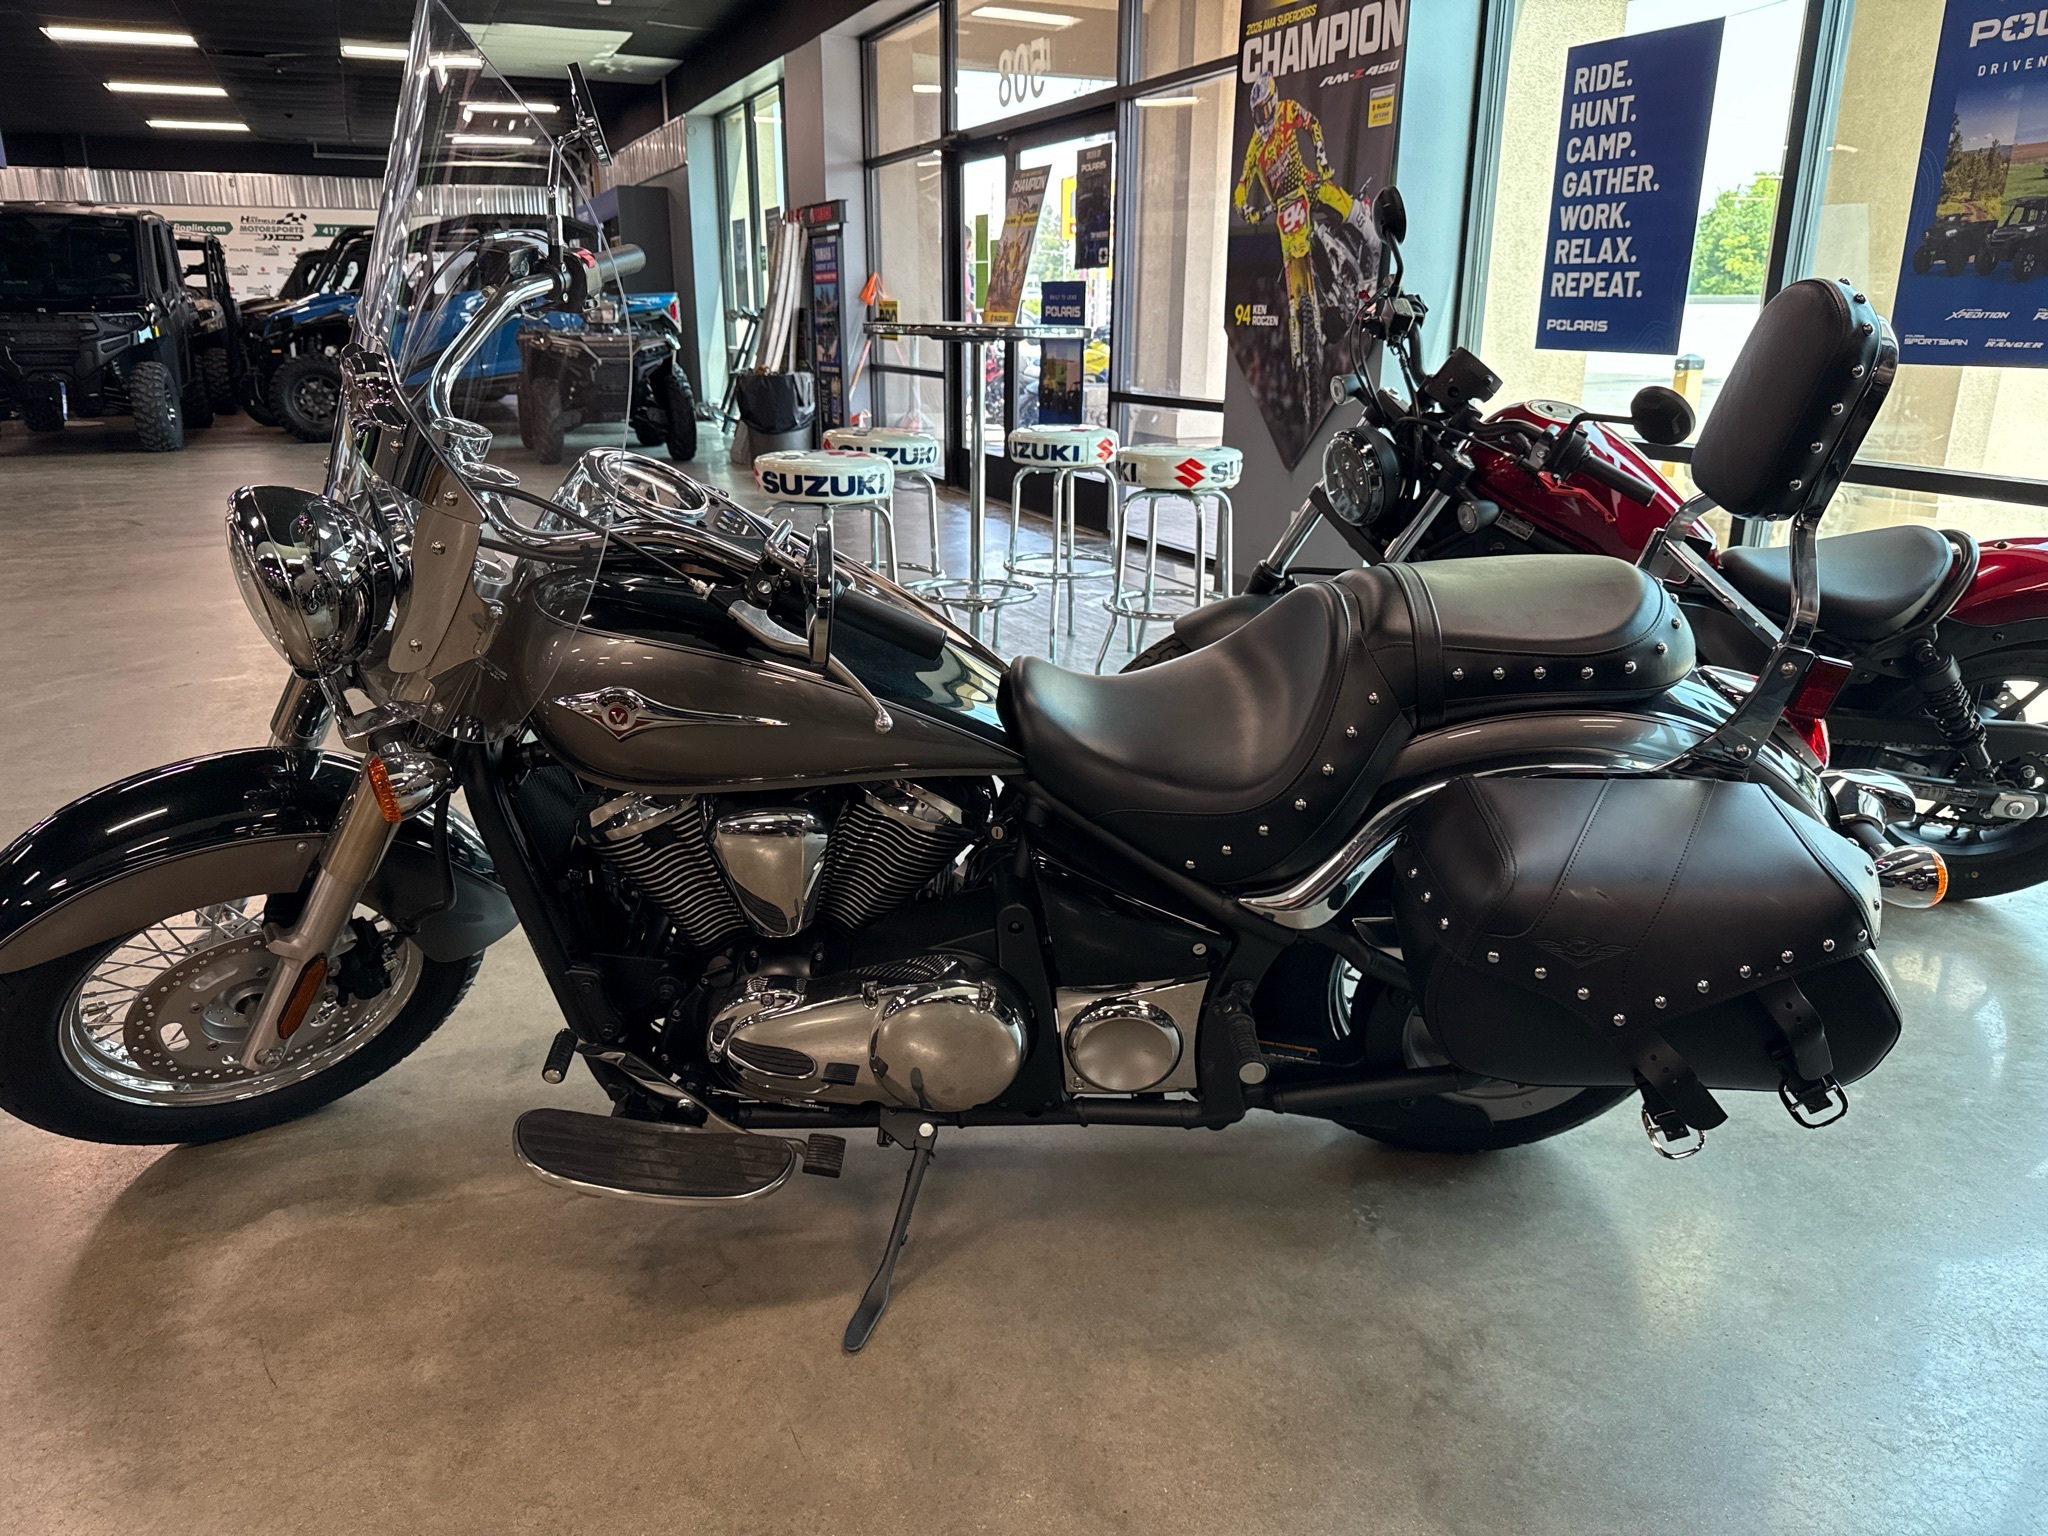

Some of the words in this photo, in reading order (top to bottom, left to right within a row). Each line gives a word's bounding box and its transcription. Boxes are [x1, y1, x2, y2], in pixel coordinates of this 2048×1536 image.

[1277, 4, 1318, 27] SUPERCROSS
[1242, 0, 1406, 84] CHAMPION
[1977, 55, 2048, 77] DRIVEN
[1573, 59, 1633, 95] RIDE.
[1569, 94, 1637, 130] HUNT.
[1566, 131, 1637, 164] CAMP.
[1081, 160, 1107, 172] POLARIS
[1012, 175, 1047, 194] CHAMPION
[1562, 164, 1660, 198] GATHER.
[241, 215, 276, 224] HATFIELD
[1283, 202, 1305, 231] 94
[1560, 201, 1631, 232] WORK.
[240, 225, 304, 233] MOTORSPORTS
[1554, 236, 1637, 264] RELAX.
[1550, 271, 1642, 298] REPEAT.
[1045, 306, 1081, 318] POLARIS
[1235, 304, 1251, 325] 94
[1252, 304, 1267, 314] KEN
[1945, 309, 2010, 320] XPEDITION
[1252, 315, 1279, 326] ROCZEN
[1545, 319, 1608, 333] POLARIS
[1904, 338, 1968, 346] SPORTSMAN
[1984, 341, 2044, 349] RANGER
[762, 470, 885, 497] SUZUKI
